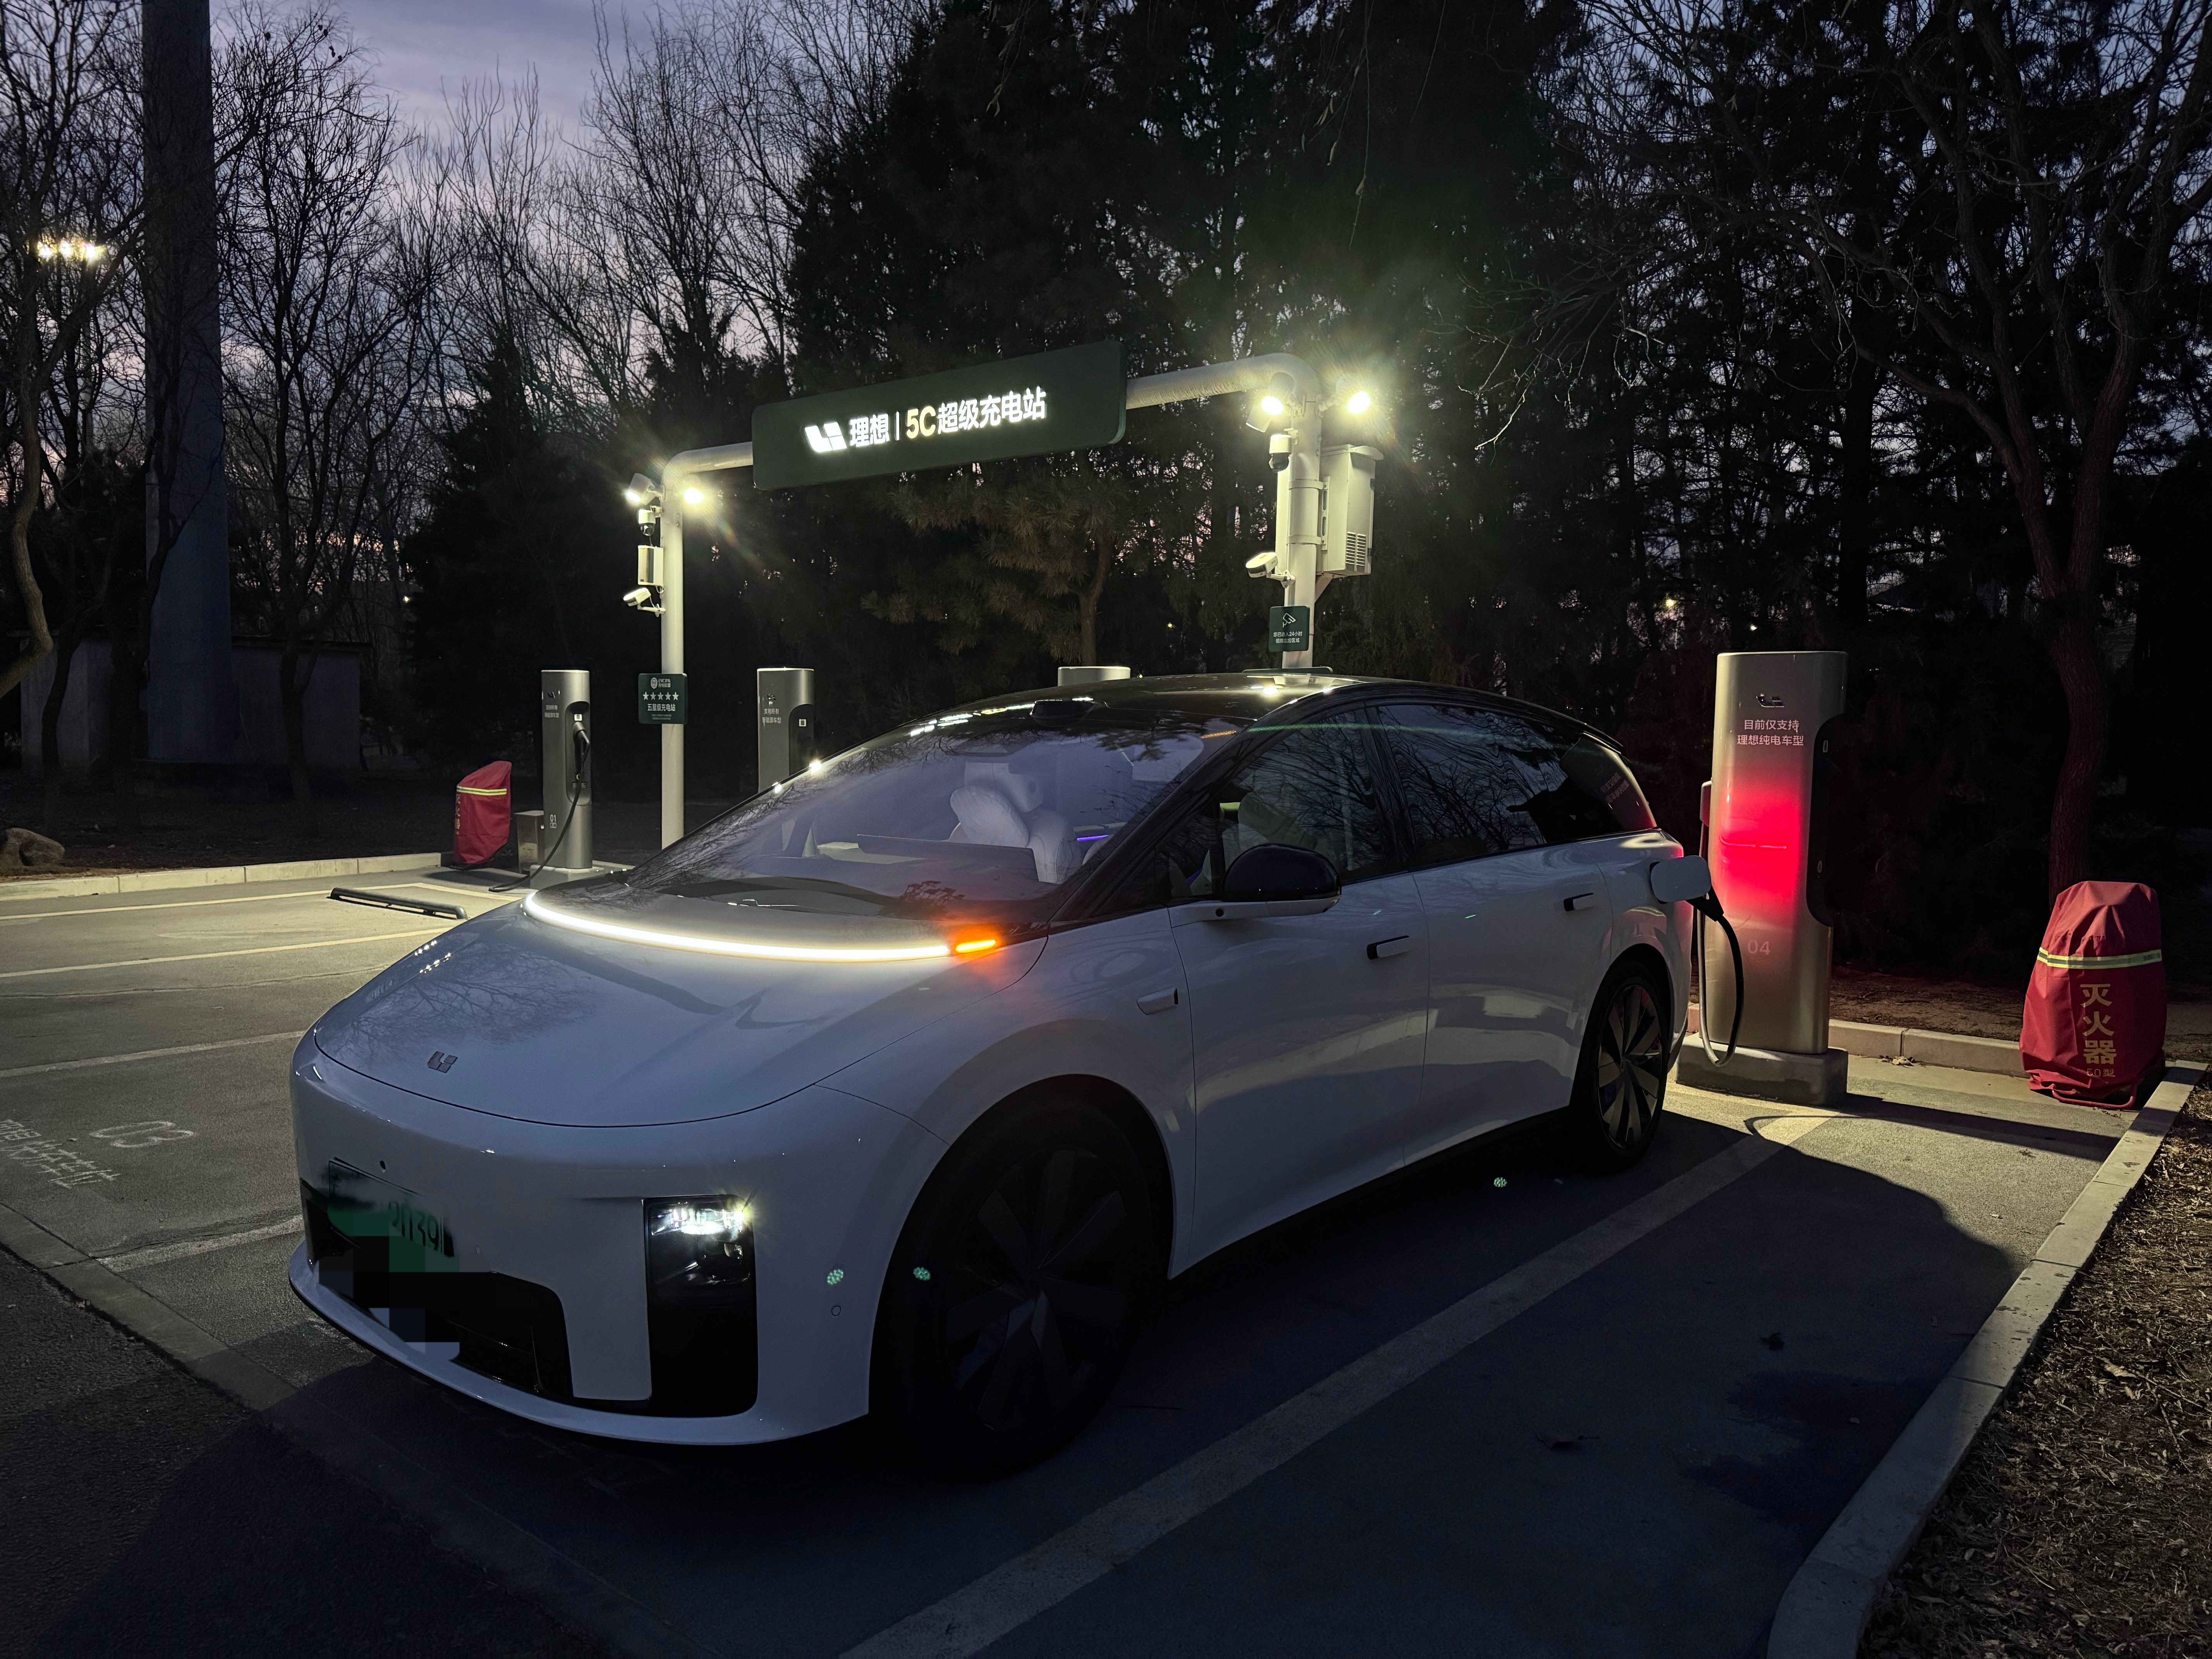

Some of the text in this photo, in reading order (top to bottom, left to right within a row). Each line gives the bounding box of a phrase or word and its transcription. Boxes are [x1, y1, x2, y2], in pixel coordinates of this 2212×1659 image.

[849, 386, 1047, 448] 理想 5C超级充电站
[647, 703, 676, 711] 五星级充电站
[1744, 719, 1799, 731] 目前仅支持
[1737, 734, 1804, 746] 理想纯电车型
[550, 814, 556, 822] 01
[1747, 940, 1771, 955] 04
[2080, 983, 2117, 1065] 灭火器
